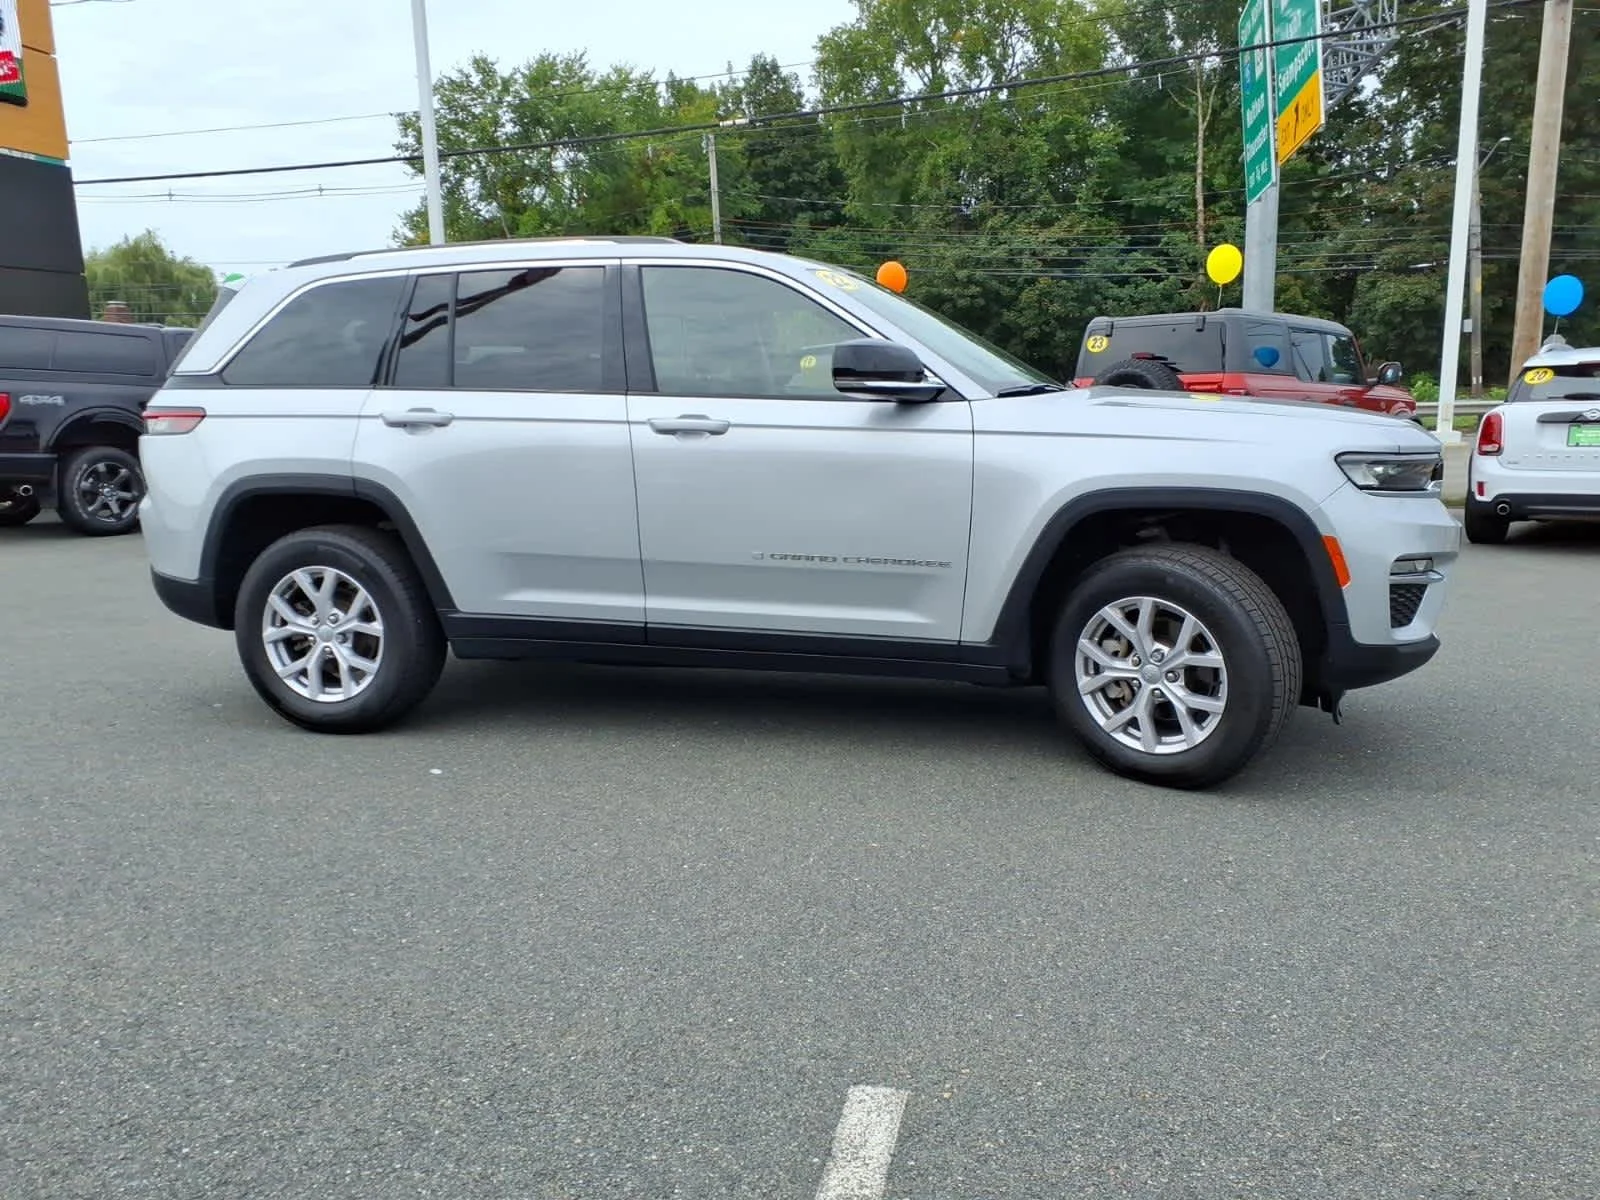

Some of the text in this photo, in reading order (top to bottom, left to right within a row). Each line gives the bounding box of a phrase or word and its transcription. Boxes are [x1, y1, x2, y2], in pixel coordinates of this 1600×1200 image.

[1091, 336, 1105, 350] 23
[1529, 369, 1549, 382] 20
[769, 552, 953, 569] GRAND CHEROKEE
